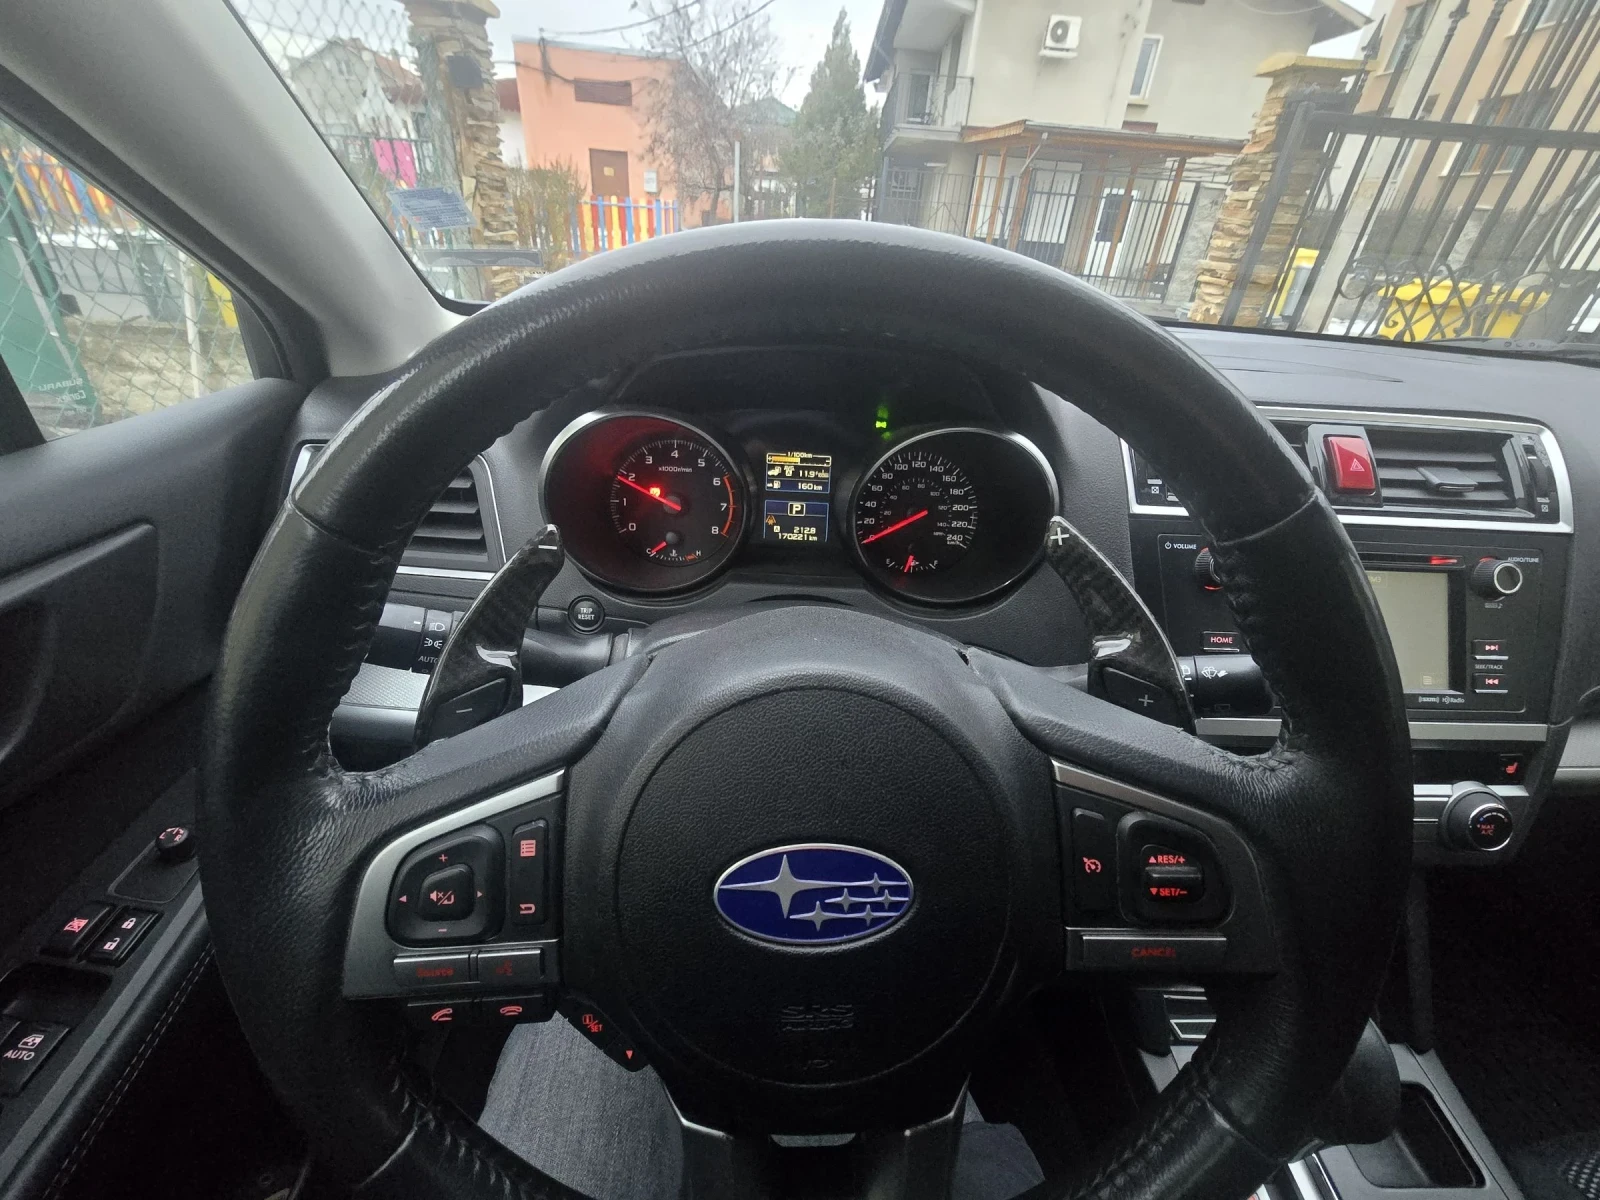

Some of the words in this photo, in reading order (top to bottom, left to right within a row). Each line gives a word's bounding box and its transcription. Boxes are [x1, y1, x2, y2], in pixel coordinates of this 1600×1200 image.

[671, 450, 679, 458] 4
[645, 456, 653, 464] 3
[698, 459, 706, 467] 5
[628, 473, 636, 482] 2
[713, 478, 721, 486] 6
[623, 498, 627, 506] 1
[793, 504, 801, 514] P
[628, 523, 637, 531] 0
[711, 526, 719, 534] 8
[4, 1049, 34, 1061] AUTO
